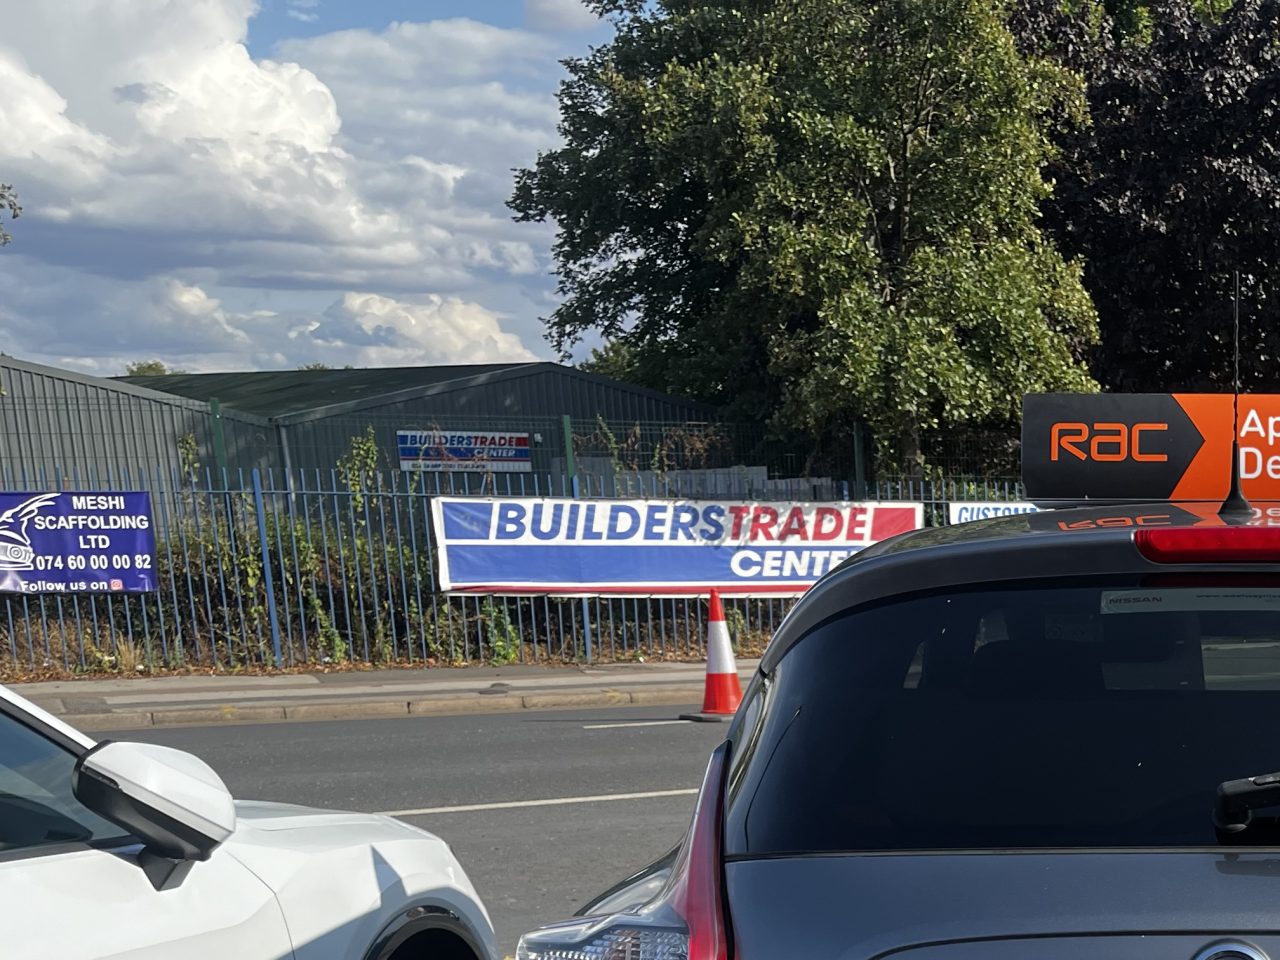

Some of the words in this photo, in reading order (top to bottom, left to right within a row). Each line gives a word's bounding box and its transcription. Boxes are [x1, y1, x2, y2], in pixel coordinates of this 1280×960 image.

[72, 496, 125, 510] MESHI
[499, 501, 868, 542] BUILDERSTRADE
[958, 506, 1038, 523] CUST
[34, 515, 149, 530] SCAFFOLDING
[79, 535, 111, 549] LTD
[35, 555, 64, 570] 074
[67, 555, 86, 570] 60
[90, 554, 109, 569] 00
[112, 554, 131, 569] 00
[134, 554, 152, 569] 82
[730, 549, 859, 578] CENTE
[20, 581, 66, 591] Follow
[70, 582, 87, 591] us
[90, 581, 108, 590] on
[1109, 596, 1163, 605] NISSAN
